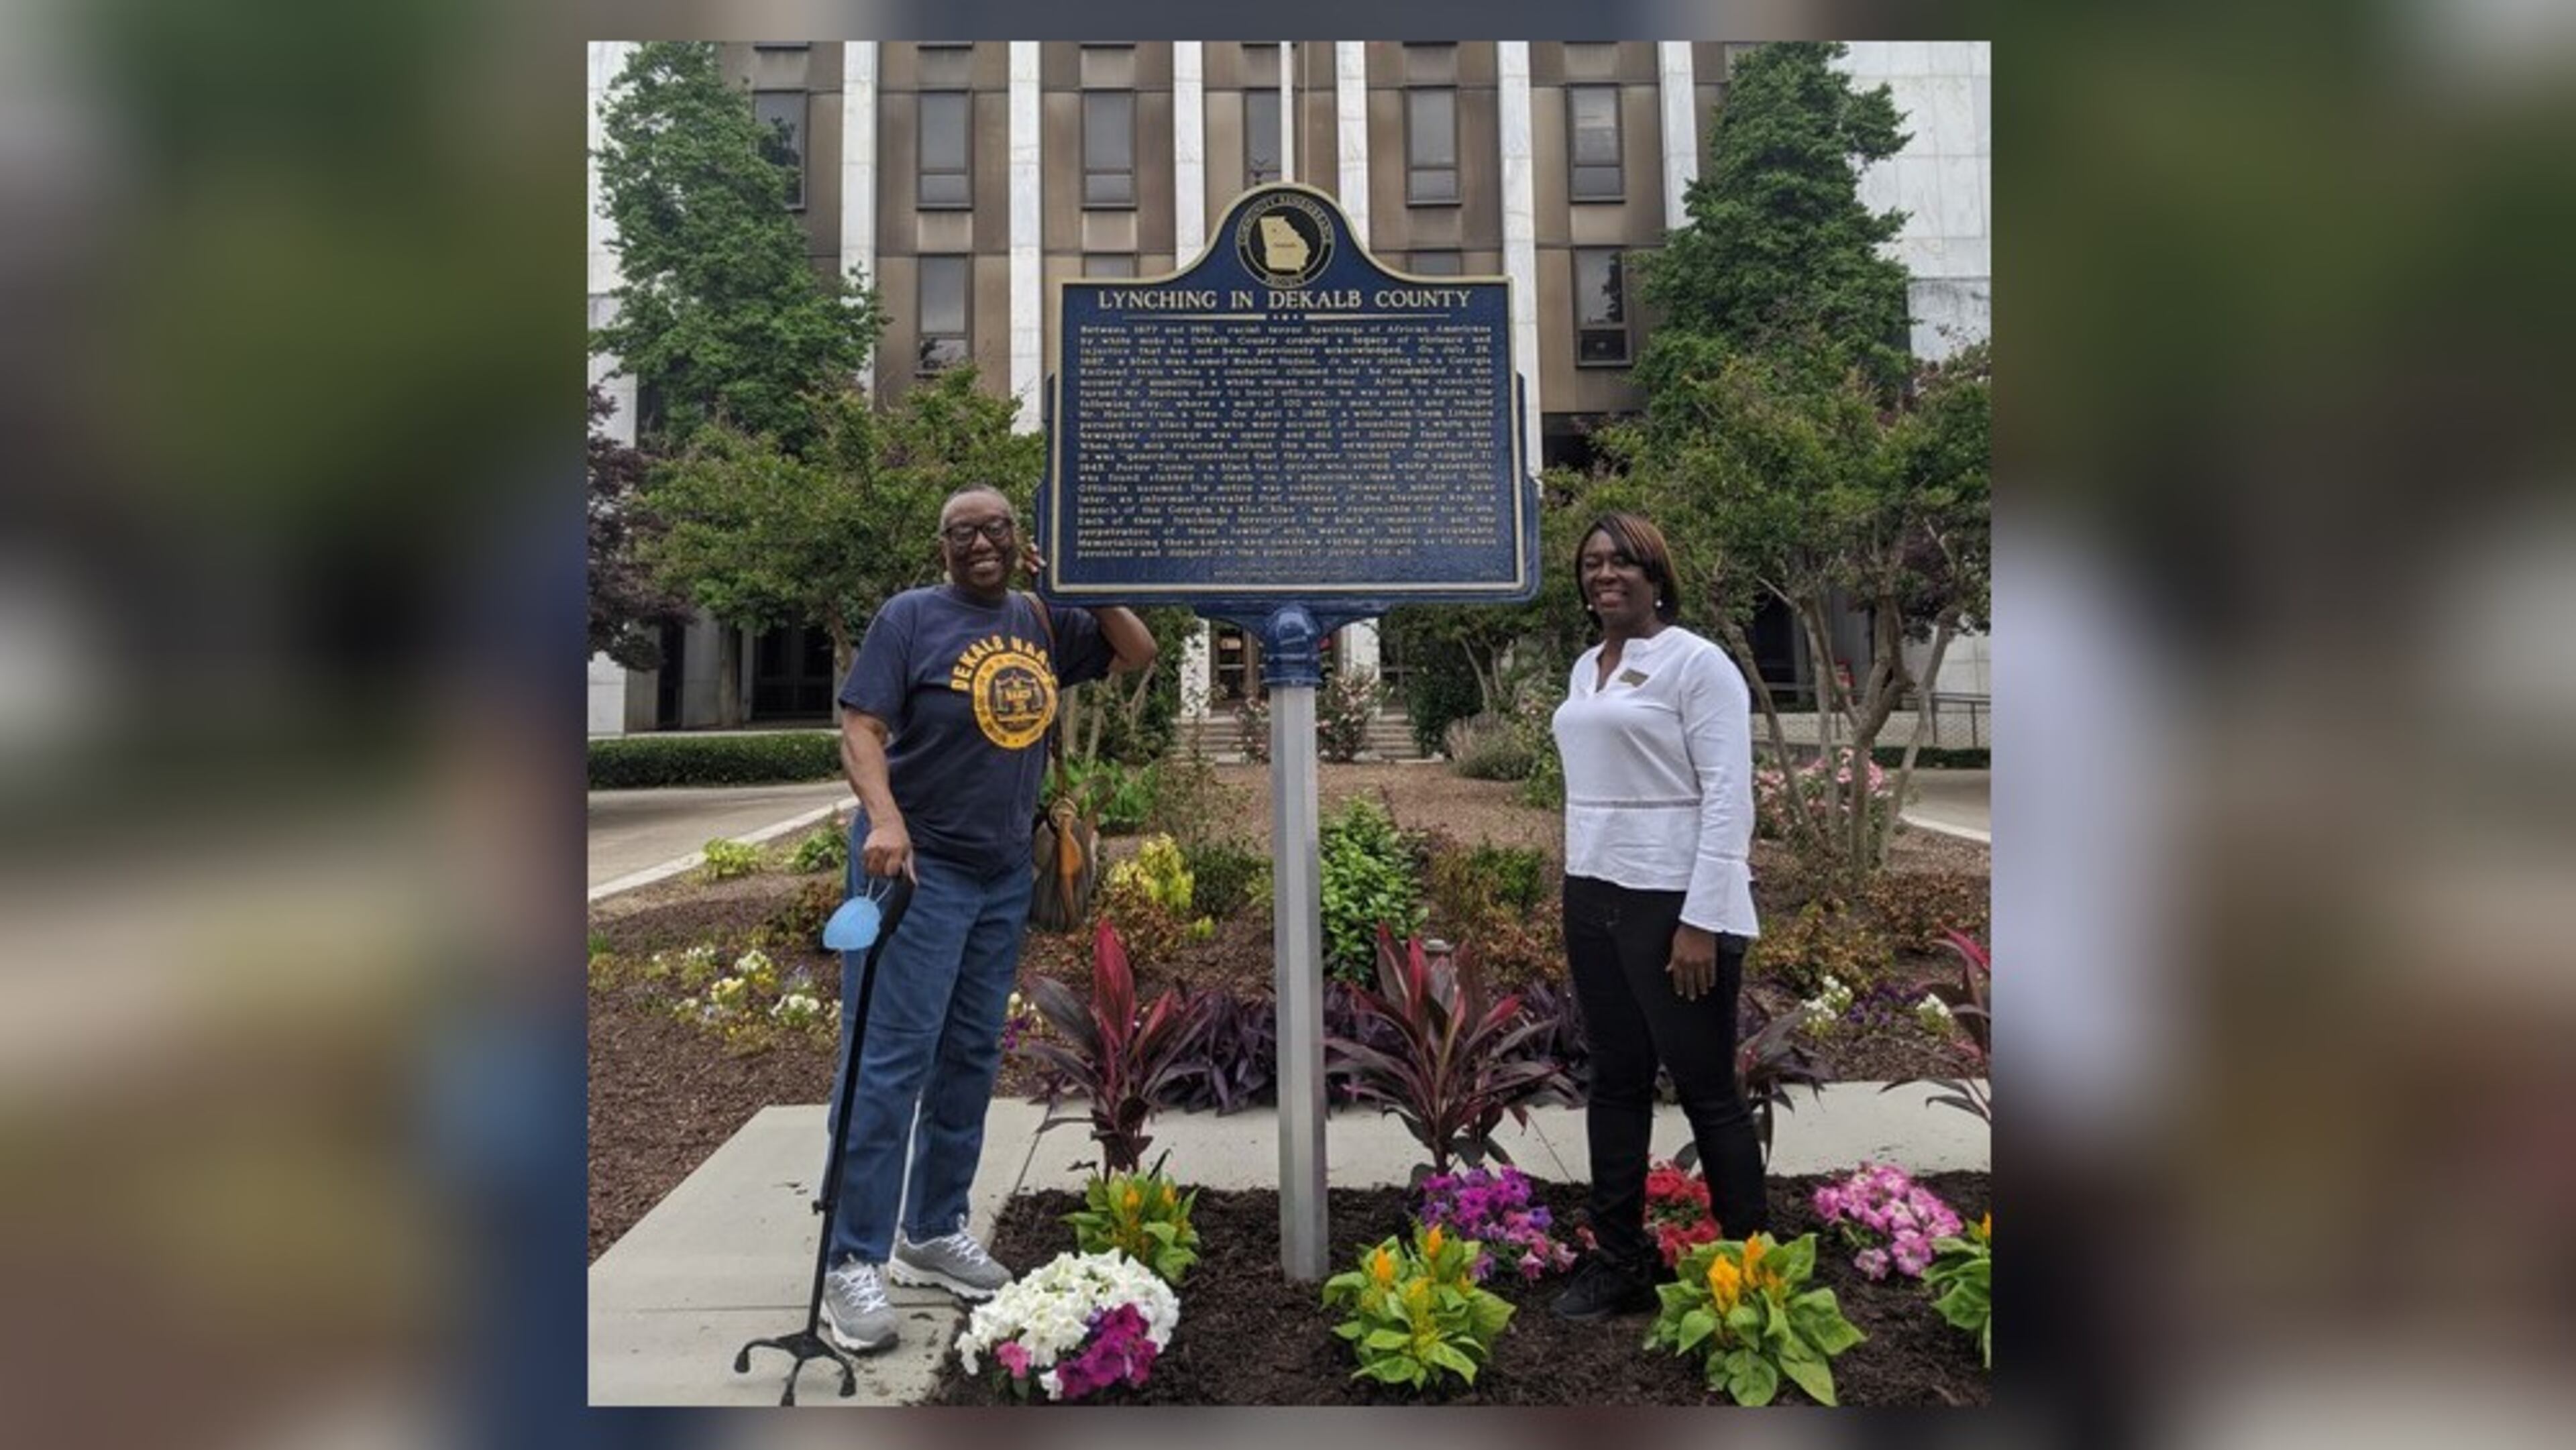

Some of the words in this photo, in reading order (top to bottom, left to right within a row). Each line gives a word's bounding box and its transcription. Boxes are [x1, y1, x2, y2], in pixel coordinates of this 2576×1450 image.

[1098, 290, 1218, 309] LYNCHING
[1230, 290, 1253, 309] IN
[1268, 290, 1362, 309] DEKALB
[1375, 290, 1471, 308] COUNTY
[951, 634, 1005, 691] DEKALB
